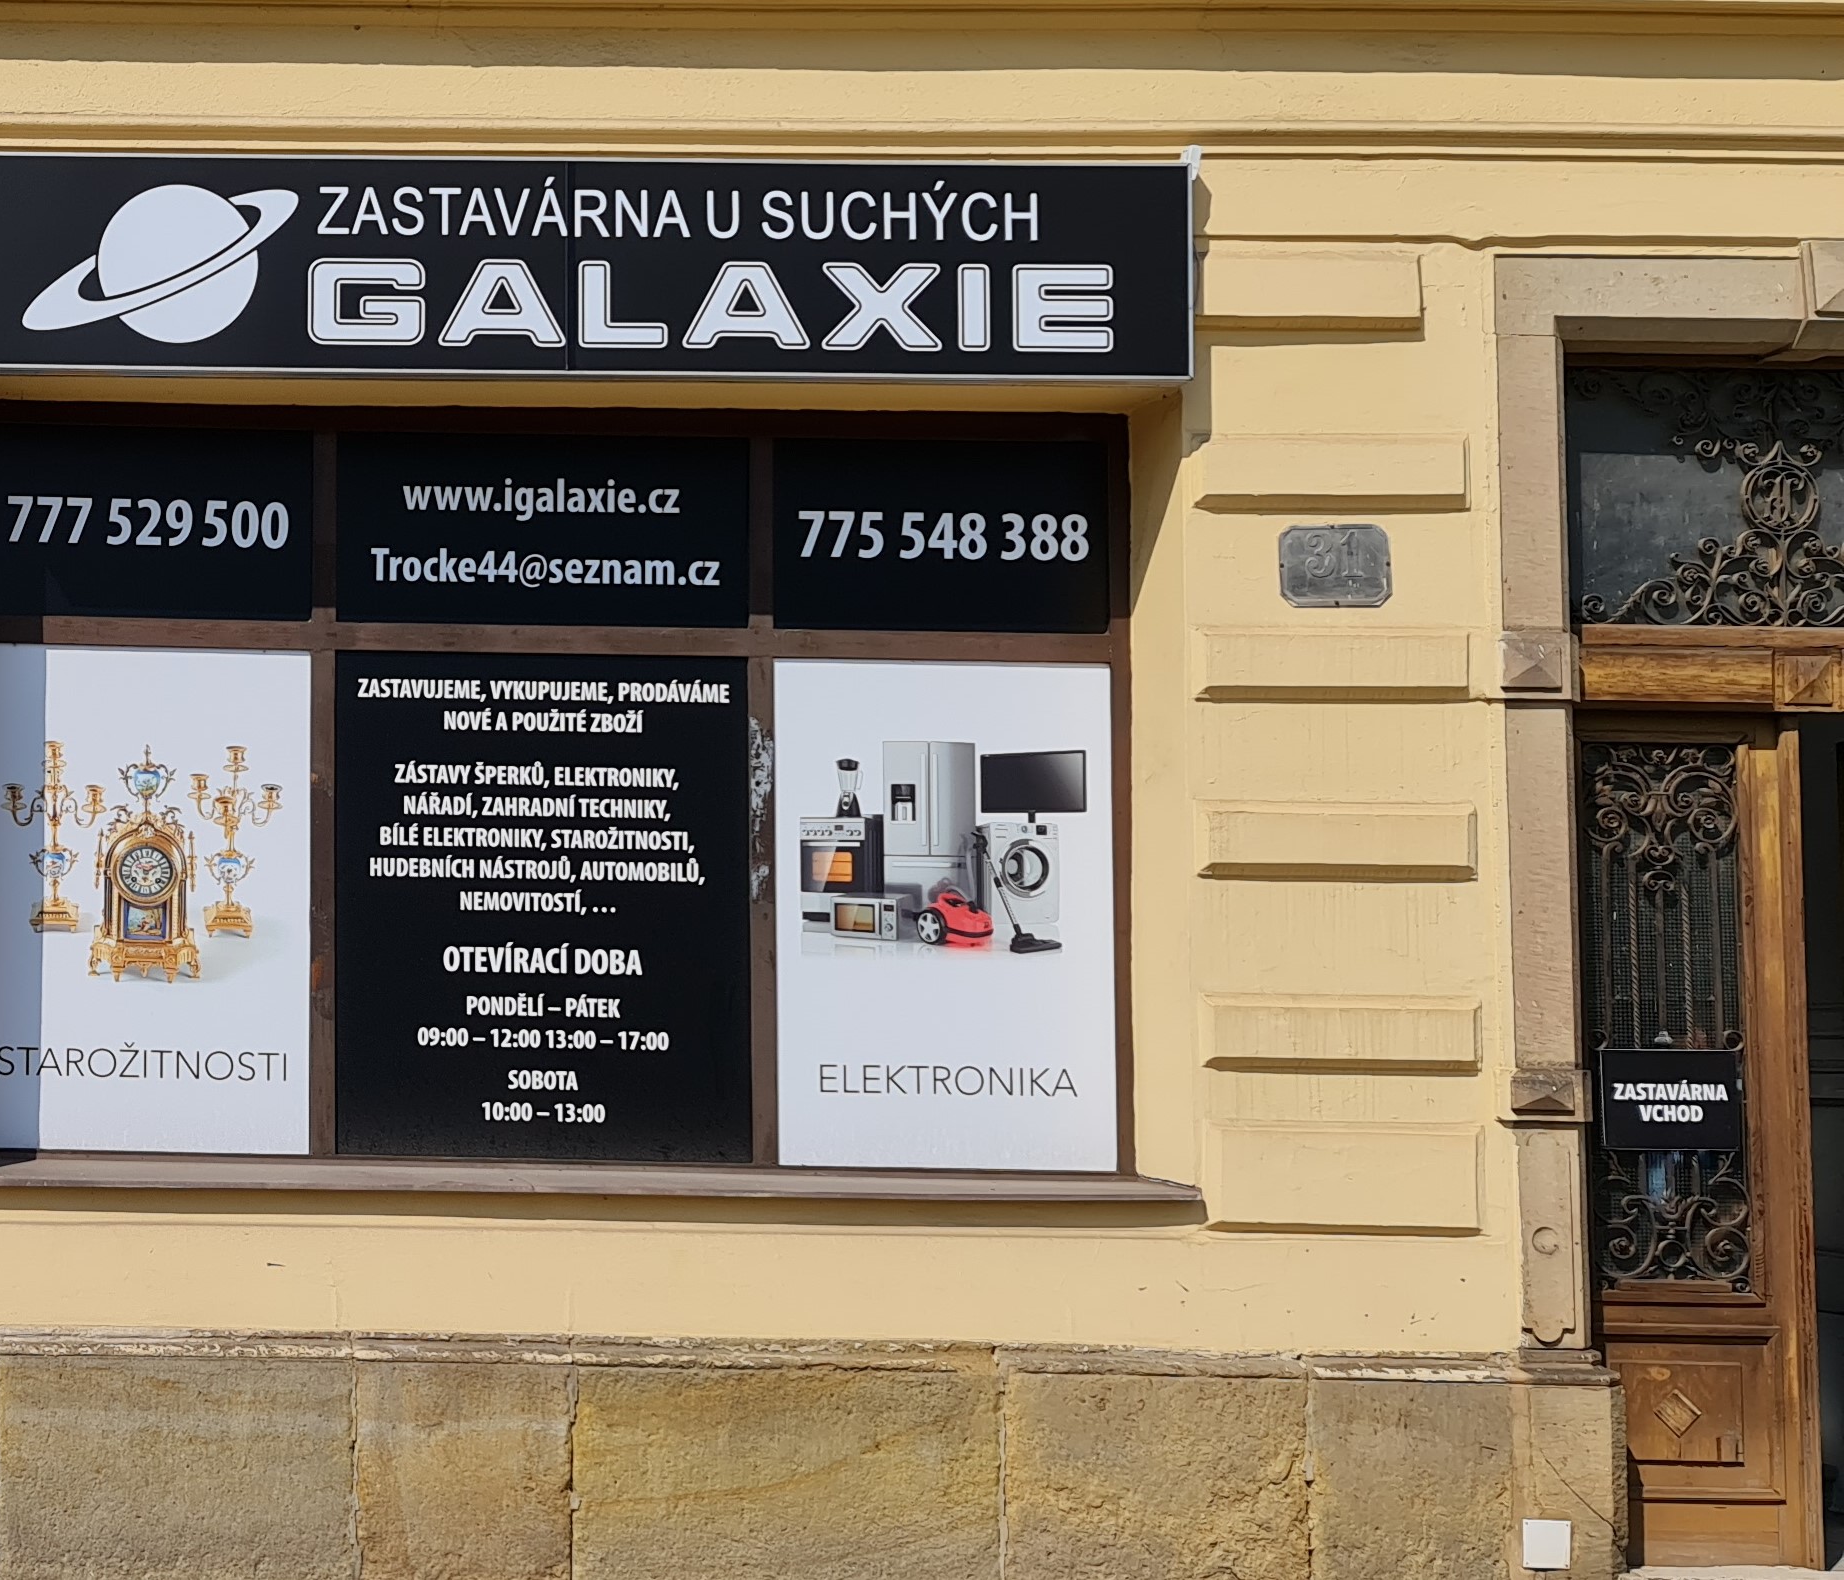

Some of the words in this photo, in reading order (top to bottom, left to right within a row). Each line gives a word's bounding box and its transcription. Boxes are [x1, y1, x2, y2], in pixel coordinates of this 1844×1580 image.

[318, 177, 690, 237] ZASTAVÁRNA
[707, 191, 739, 238] U
[762, 181, 1037, 241] SUCHÝCH
[308, 258, 1113, 352] GALAXIE
[403, 478, 679, 521] www.igalaxie.cz
[8, 496, 92, 543] 777
[107, 499, 192, 546] 529
[202, 500, 288, 549] 500
[799, 511, 883, 558] 775
[900, 512, 987, 560] 548
[1001, 513, 1089, 561] 388
[371, 548, 719, 587] Trocke44@seznam.cz
[1305, 529, 1364, 578] 31
[358, 679, 486, 702] ZASTAVUJEME,
[490, 681, 613, 704] VYKUPUJEME,
[619, 680, 729, 703] PRODÁVÁME
[444, 708, 491, 730] NOVÉ
[495, 712, 507, 730] A
[513, 709, 586, 732] POUŽITÉ
[590, 710, 643, 733] ZBOŽÍ
[395, 761, 471, 784] ZÁSTAVY
[475, 761, 549, 788] ŠPERKŮ,
[555, 767, 678, 790] ELEKTRONIKY,
[404, 792, 478, 818] NÁŘADÍ,
[482, 794, 576, 817] ZAHRADNÍ
[578, 799, 670, 821] TECHNIKY,
[380, 823, 418, 845] BÍLÉ
[424, 827, 546, 851] ELEKTRONIKY,
[551, 827, 694, 853] STAROŽITNOSTI,
[370, 855, 474, 878] HUDEBNÍCH
[480, 856, 576, 882] NÁSTROJŮ,
[580, 858, 705, 885] AUTOMOBILŮ,
[460, 889, 586, 915] NEMOVITOSTÍ,
[443, 942, 569, 973] OTEVÍRACÍ
[575, 949, 642, 975] DOBA
[467, 993, 544, 1016] PONDĚLÍ
[566, 994, 620, 1018] PÁTEK
[418, 1027, 468, 1046] 09:00
[490, 1029, 540, 1048] 12:00
[546, 1030, 596, 1049] 13:00
[618, 1031, 669, 1050] 17:00
[508, 1070, 578, 1090] SOBOTA
[820, 1065, 1077, 1096] ELEKTRONIKA
[1614, 1080, 1728, 1100] ZASTAVÁRNA
[482, 1102, 532, 1121] 10:00
[554, 1104, 605, 1123] 13:00
[1639, 1105, 1703, 1122] VCHOD
